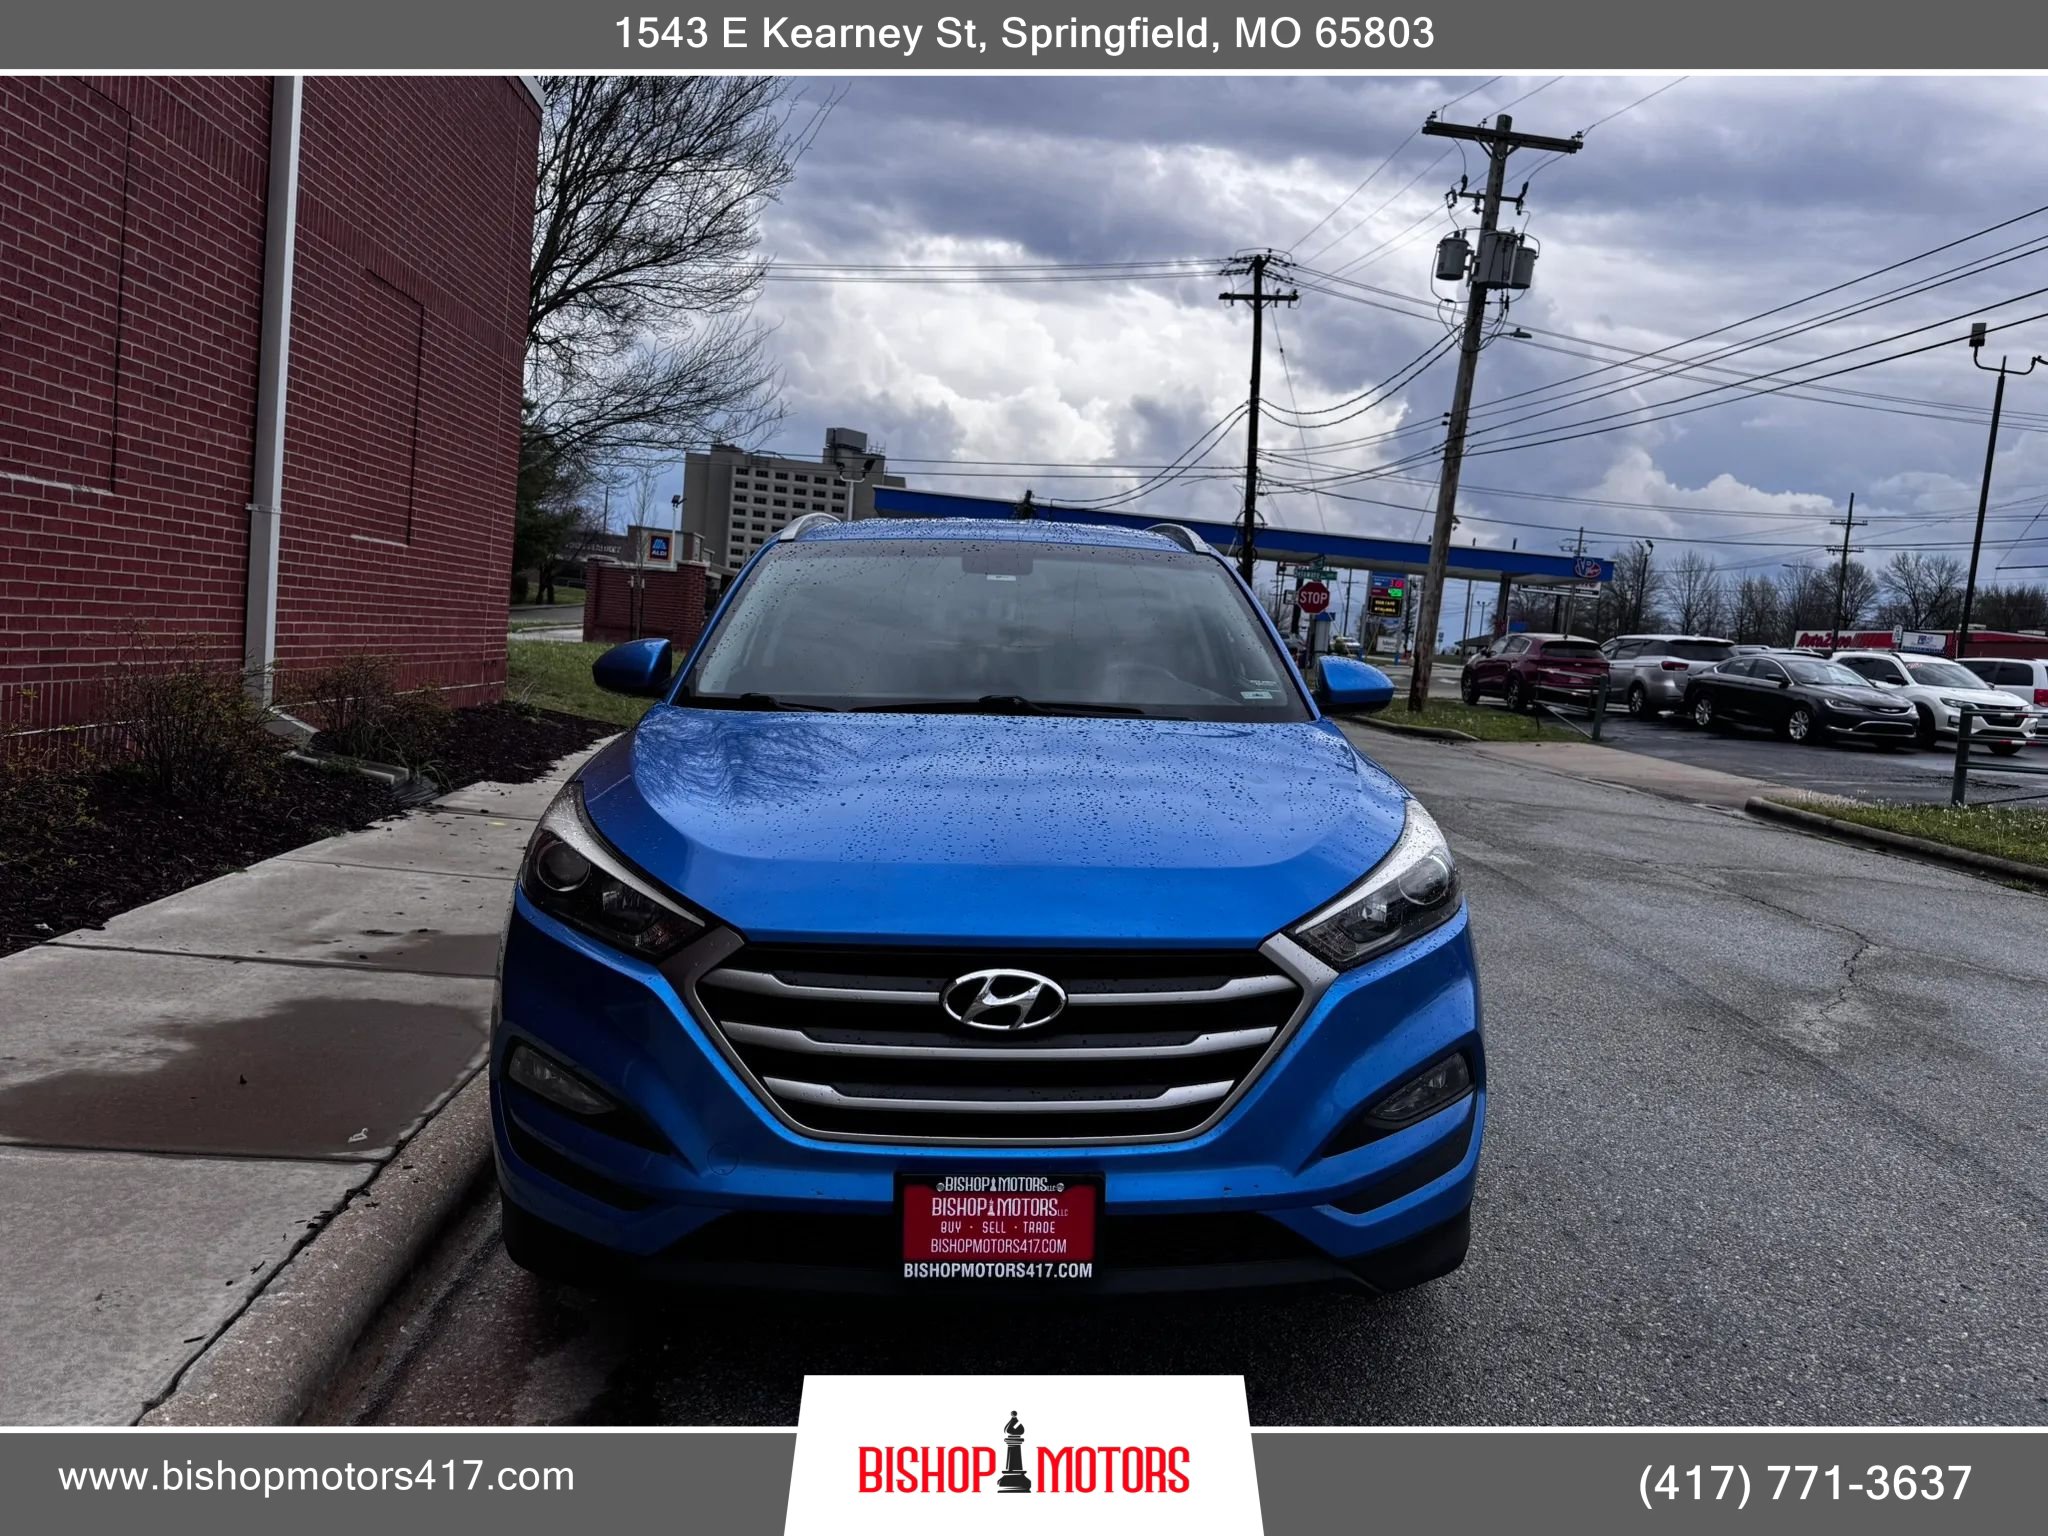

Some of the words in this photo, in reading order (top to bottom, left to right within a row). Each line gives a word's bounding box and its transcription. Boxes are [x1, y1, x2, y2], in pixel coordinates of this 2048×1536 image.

[1300, 592, 1328, 605] STOP
[945, 1177, 990, 1192] BISHOP
[998, 1177, 1047, 1192] MOTORS
[932, 1197, 988, 1217] BISHOP
[997, 1197, 1057, 1217] MOTORS
[1057, 1208, 1069, 1217] LLC
[940, 1221, 961, 1234] BUY
[982, 1221, 1006, 1234] SELL
[1023, 1221, 1056, 1234] TRADE
[931, 1238, 1067, 1254] BISHOPMOTORS417.COM
[904, 1262, 1093, 1278] BISHOPMOTORS417.COM
